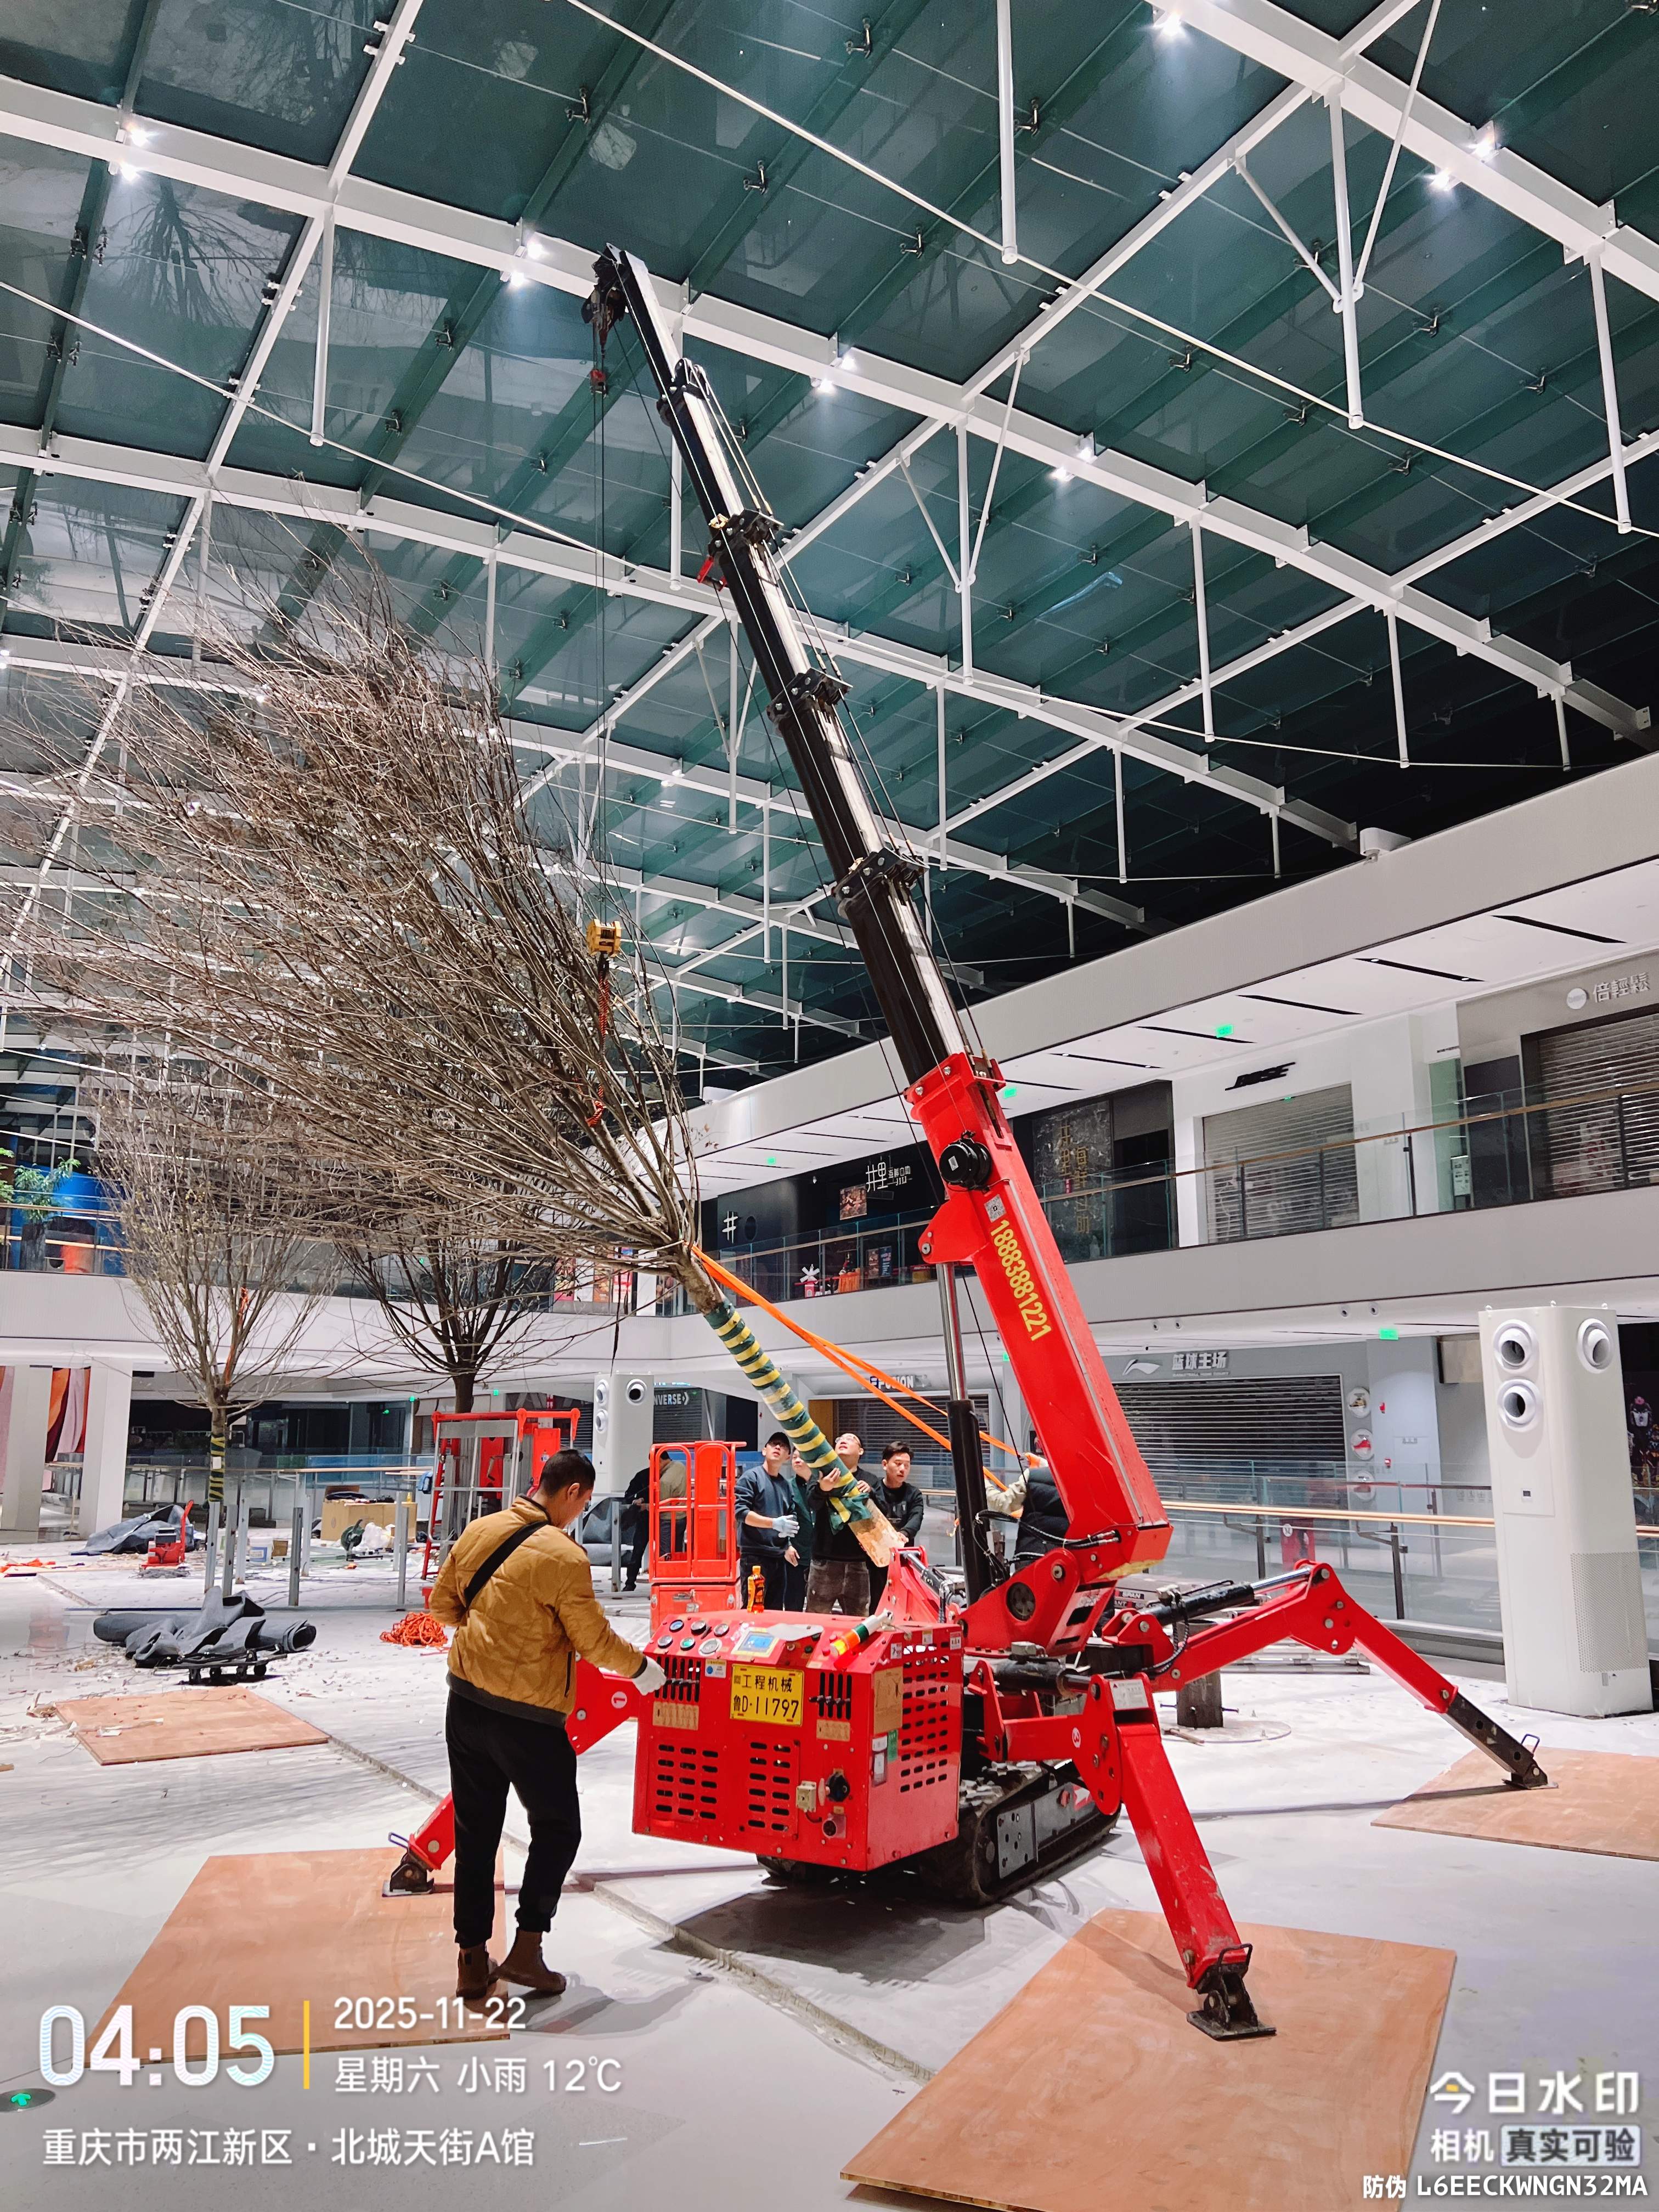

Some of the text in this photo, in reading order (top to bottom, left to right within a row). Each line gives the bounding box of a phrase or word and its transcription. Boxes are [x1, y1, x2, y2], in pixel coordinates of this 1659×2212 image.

[990, 1220, 1052, 1341] 18883881221
[1172, 1351, 1227, 1370] 篮球主场
[741, 1674, 792, 1693] 工程机械
